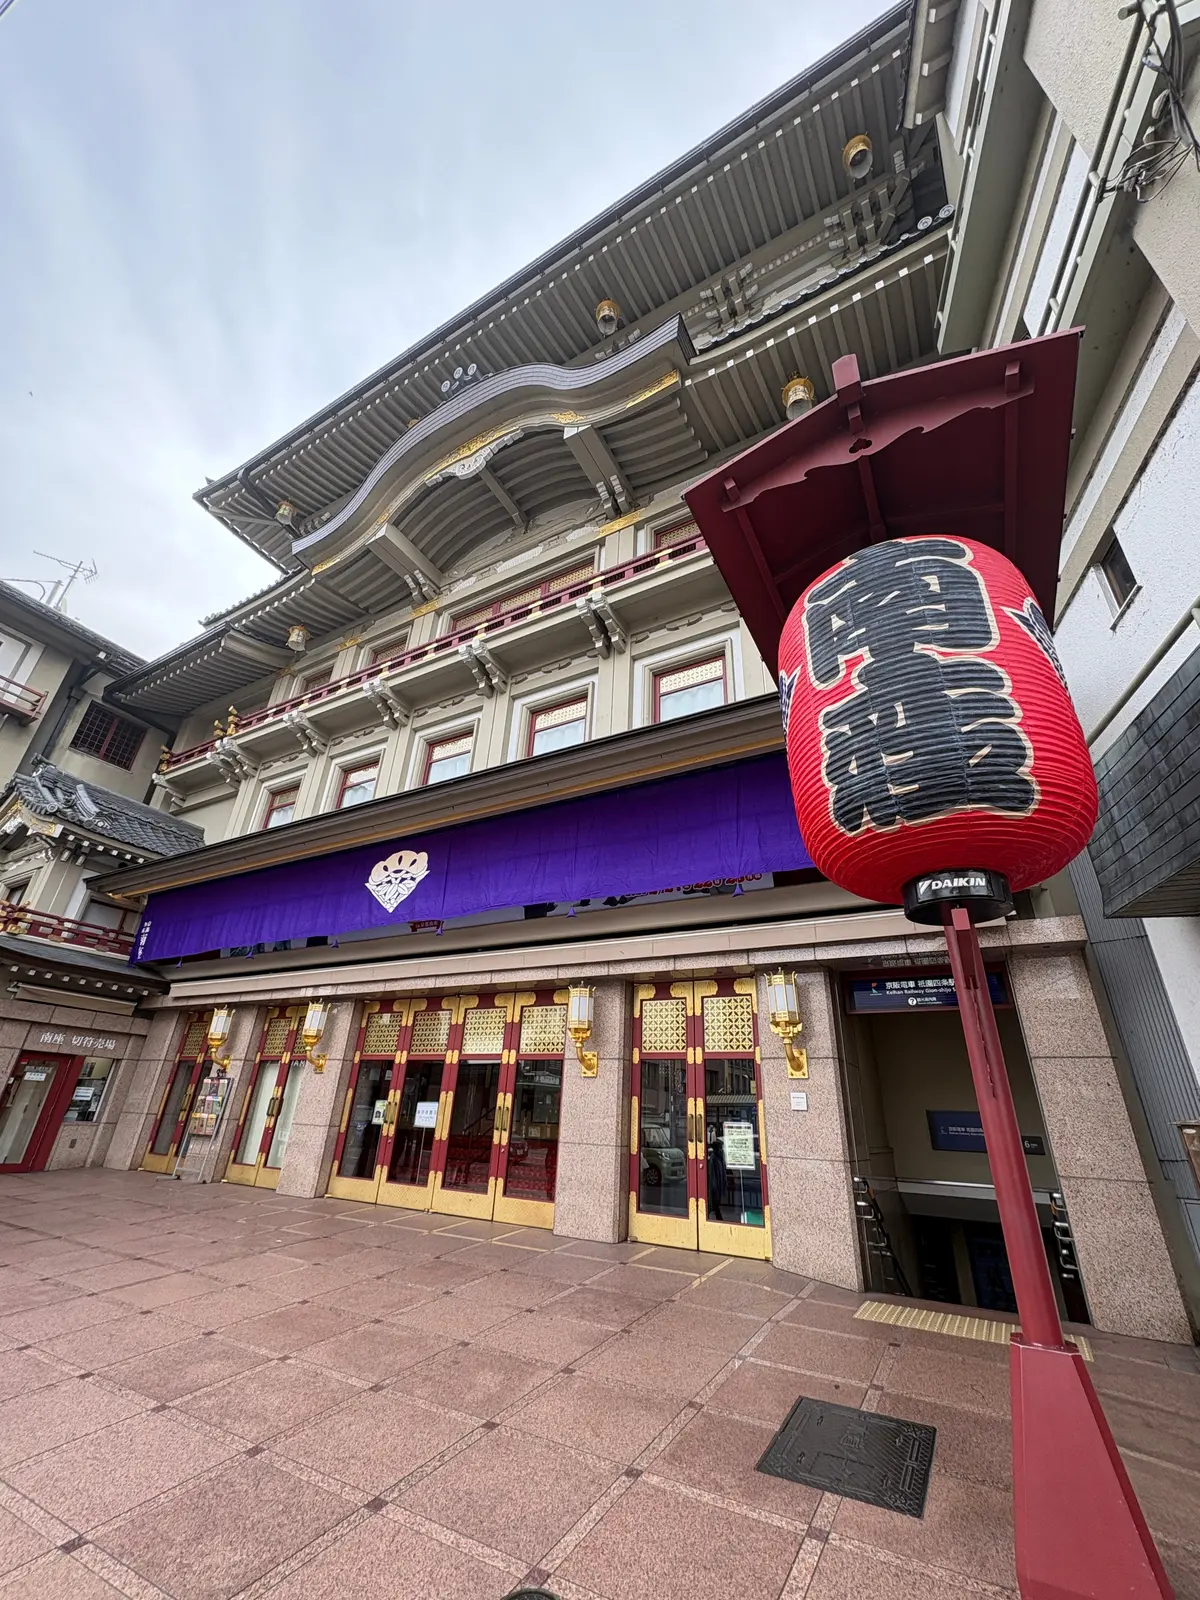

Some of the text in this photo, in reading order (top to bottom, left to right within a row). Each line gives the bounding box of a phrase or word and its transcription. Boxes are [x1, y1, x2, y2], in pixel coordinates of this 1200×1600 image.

[931, 877, 986, 890] DAIKIN
[885, 980, 915, 990] 京阪電車
[40, 1032, 116, 1050] 南座 切符売場
[1024, 1140, 1031, 1149] 6
